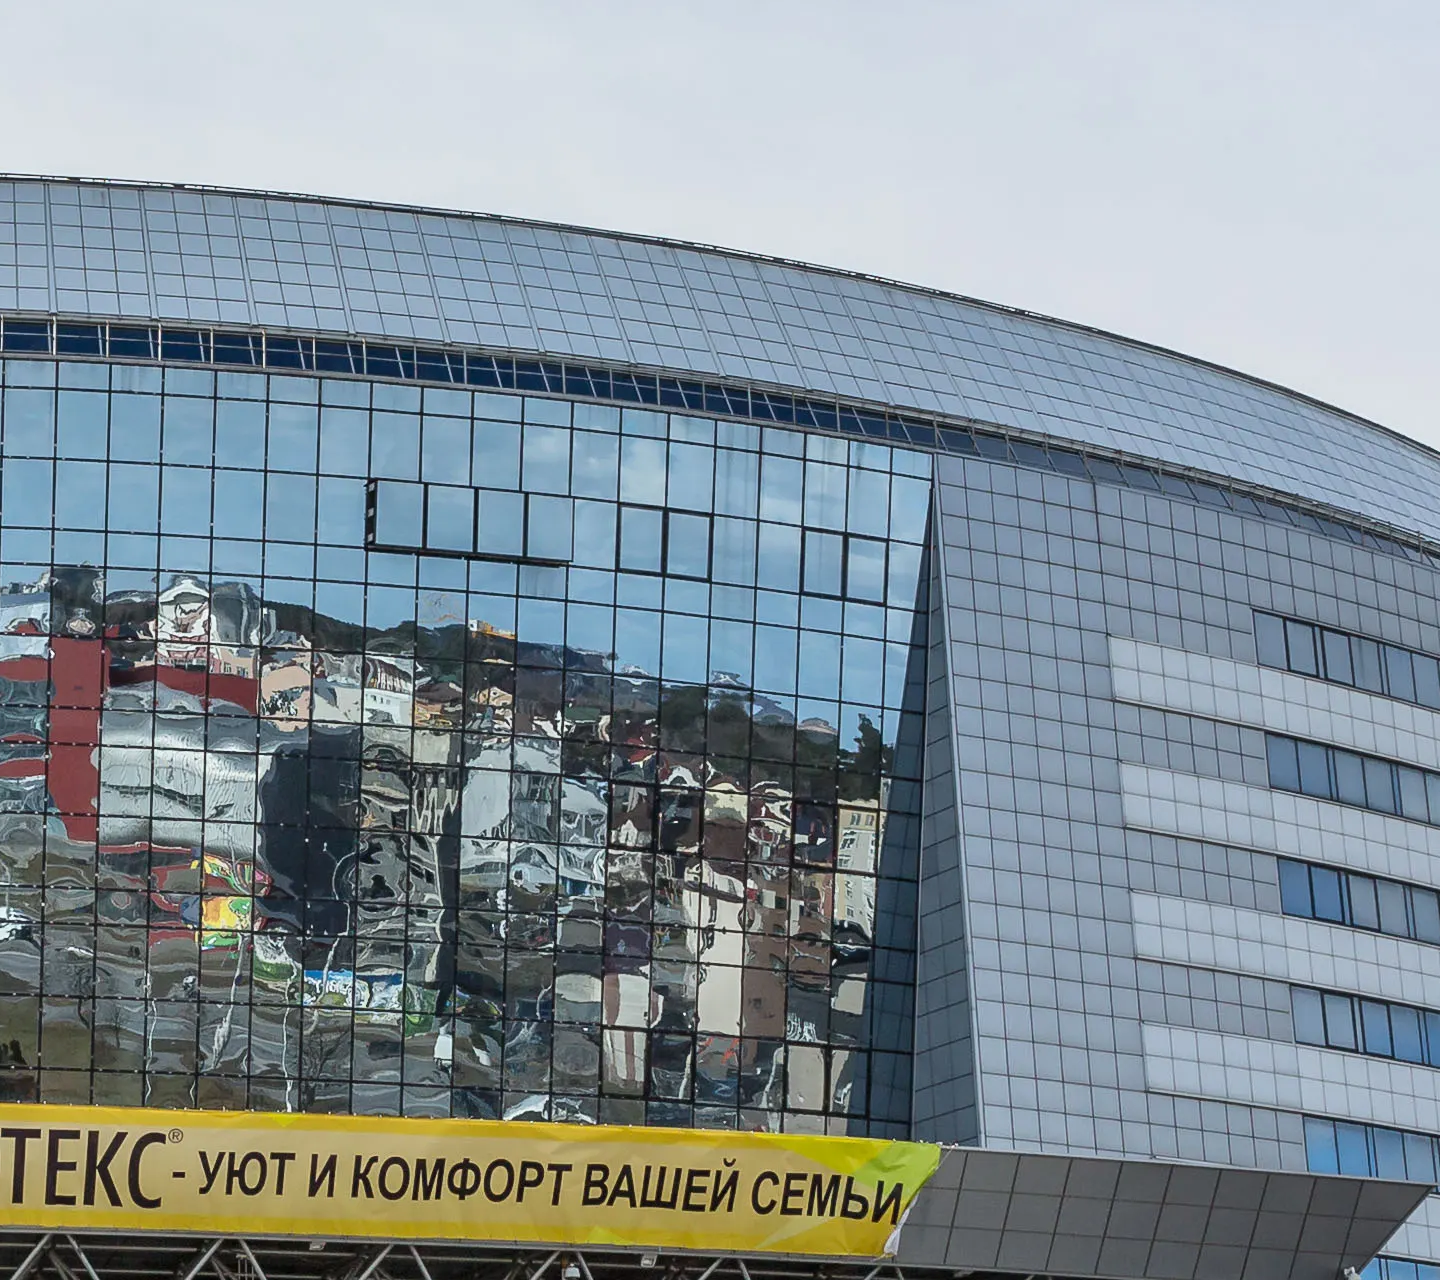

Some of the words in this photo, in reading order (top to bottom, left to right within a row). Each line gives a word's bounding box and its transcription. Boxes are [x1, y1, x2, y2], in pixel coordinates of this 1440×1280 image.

[198, 1150, 296, 1195] УЮТ
[308, 1153, 338, 1197] И
[351, 1154, 574, 1206] КОМФОРТ
[581, 1157, 739, 1212] ВАШЕЙ
[750, 1169, 905, 1226] СЕМЬИ
